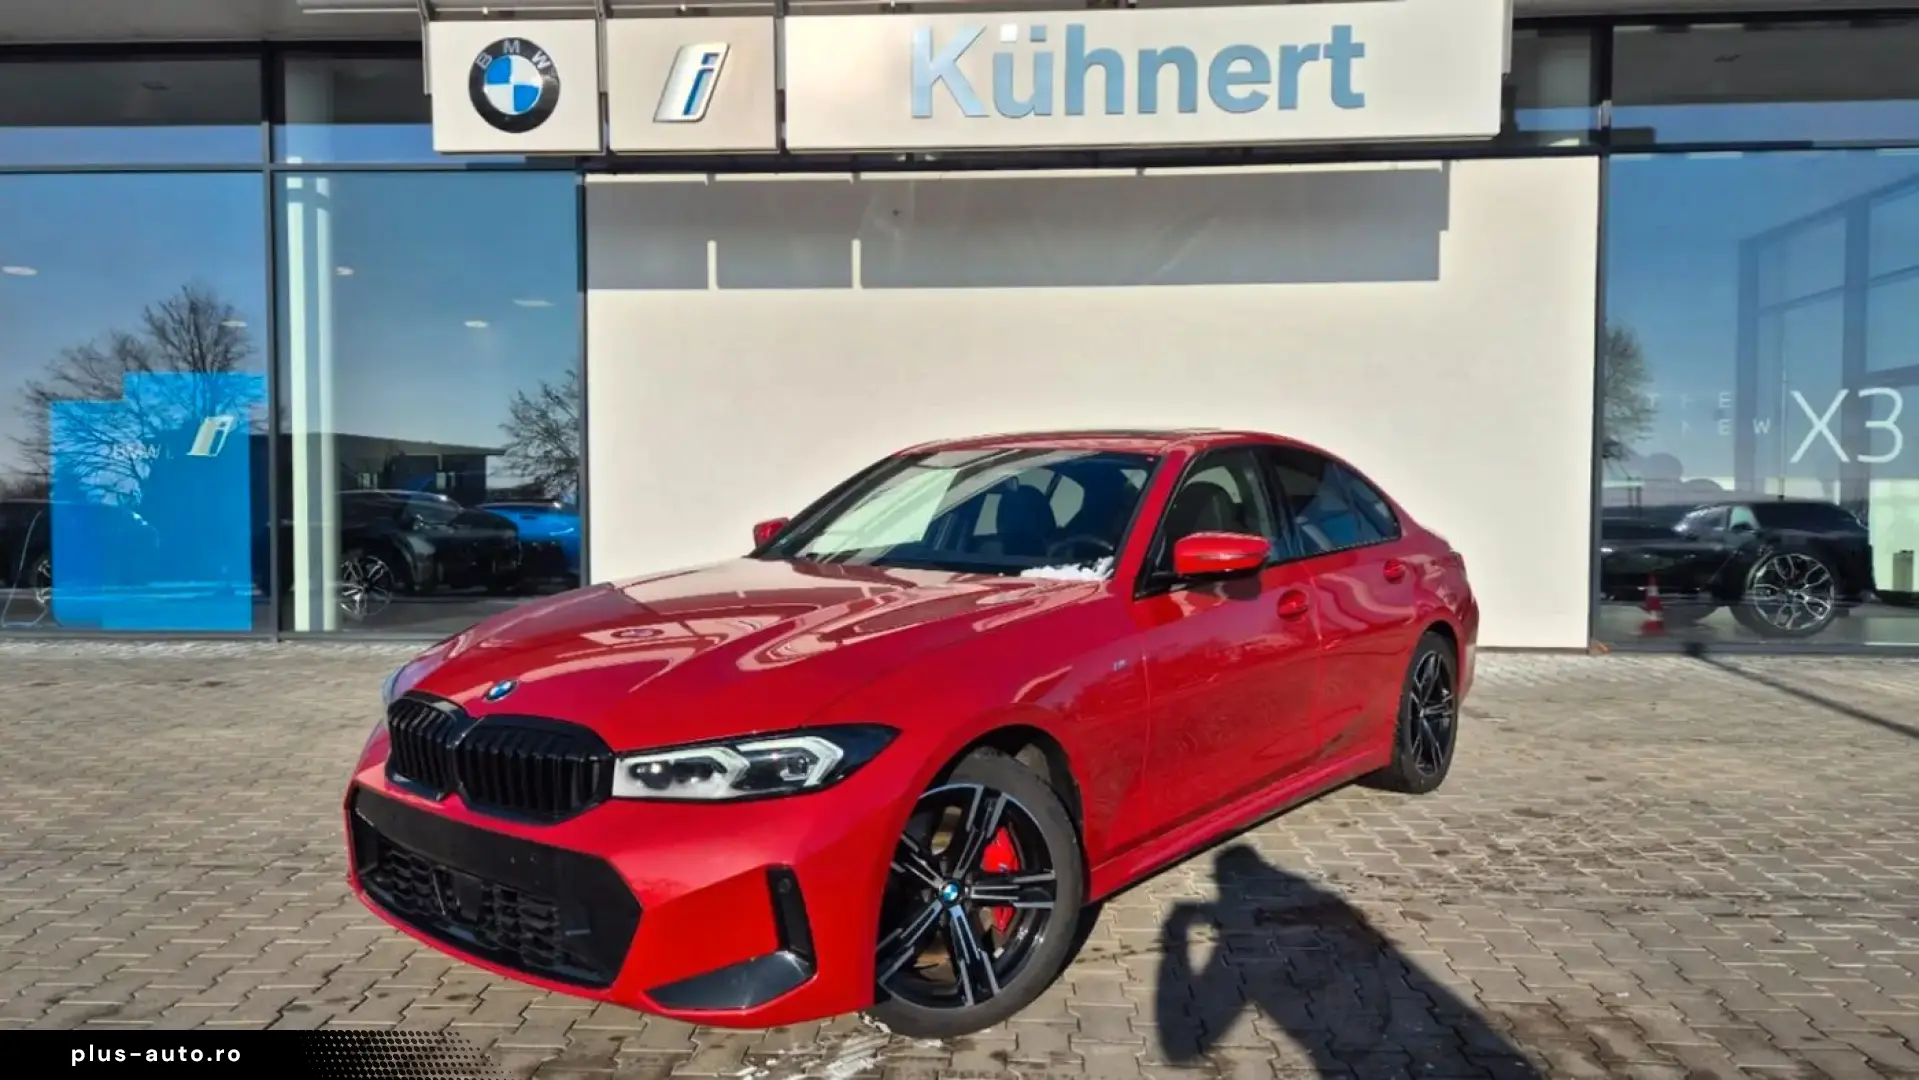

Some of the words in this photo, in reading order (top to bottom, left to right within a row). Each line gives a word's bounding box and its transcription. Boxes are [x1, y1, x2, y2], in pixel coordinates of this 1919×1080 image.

[475, 39, 552, 70] BMW
[911, 23, 1367, 119] Kühnert
[1789, 387, 1904, 464] X3
